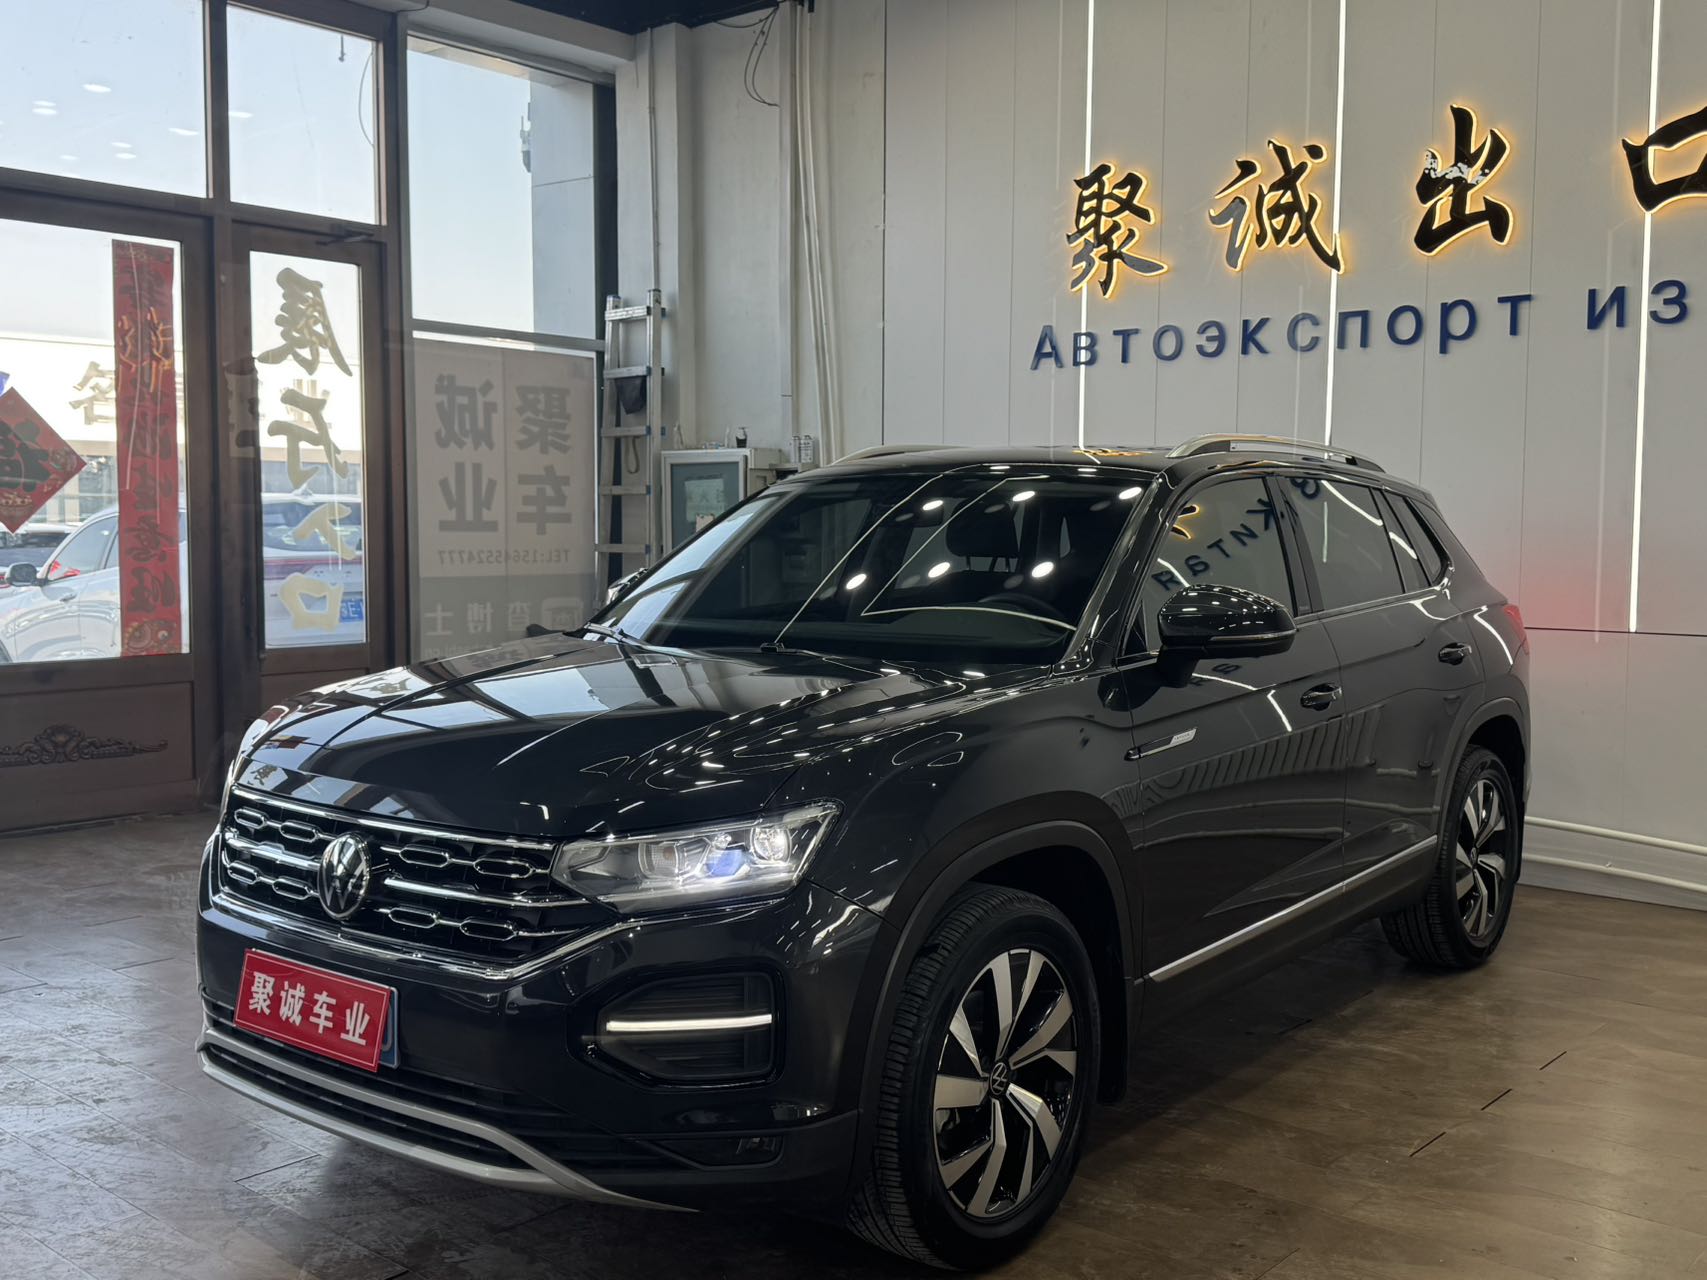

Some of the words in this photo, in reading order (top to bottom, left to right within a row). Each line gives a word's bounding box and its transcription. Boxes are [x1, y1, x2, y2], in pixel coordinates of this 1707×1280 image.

[1030, 293, 1533, 371] Автоэкспорт
[1586, 279, 1690, 332] из
[248, 971, 370, 1046] 聚诚车业
